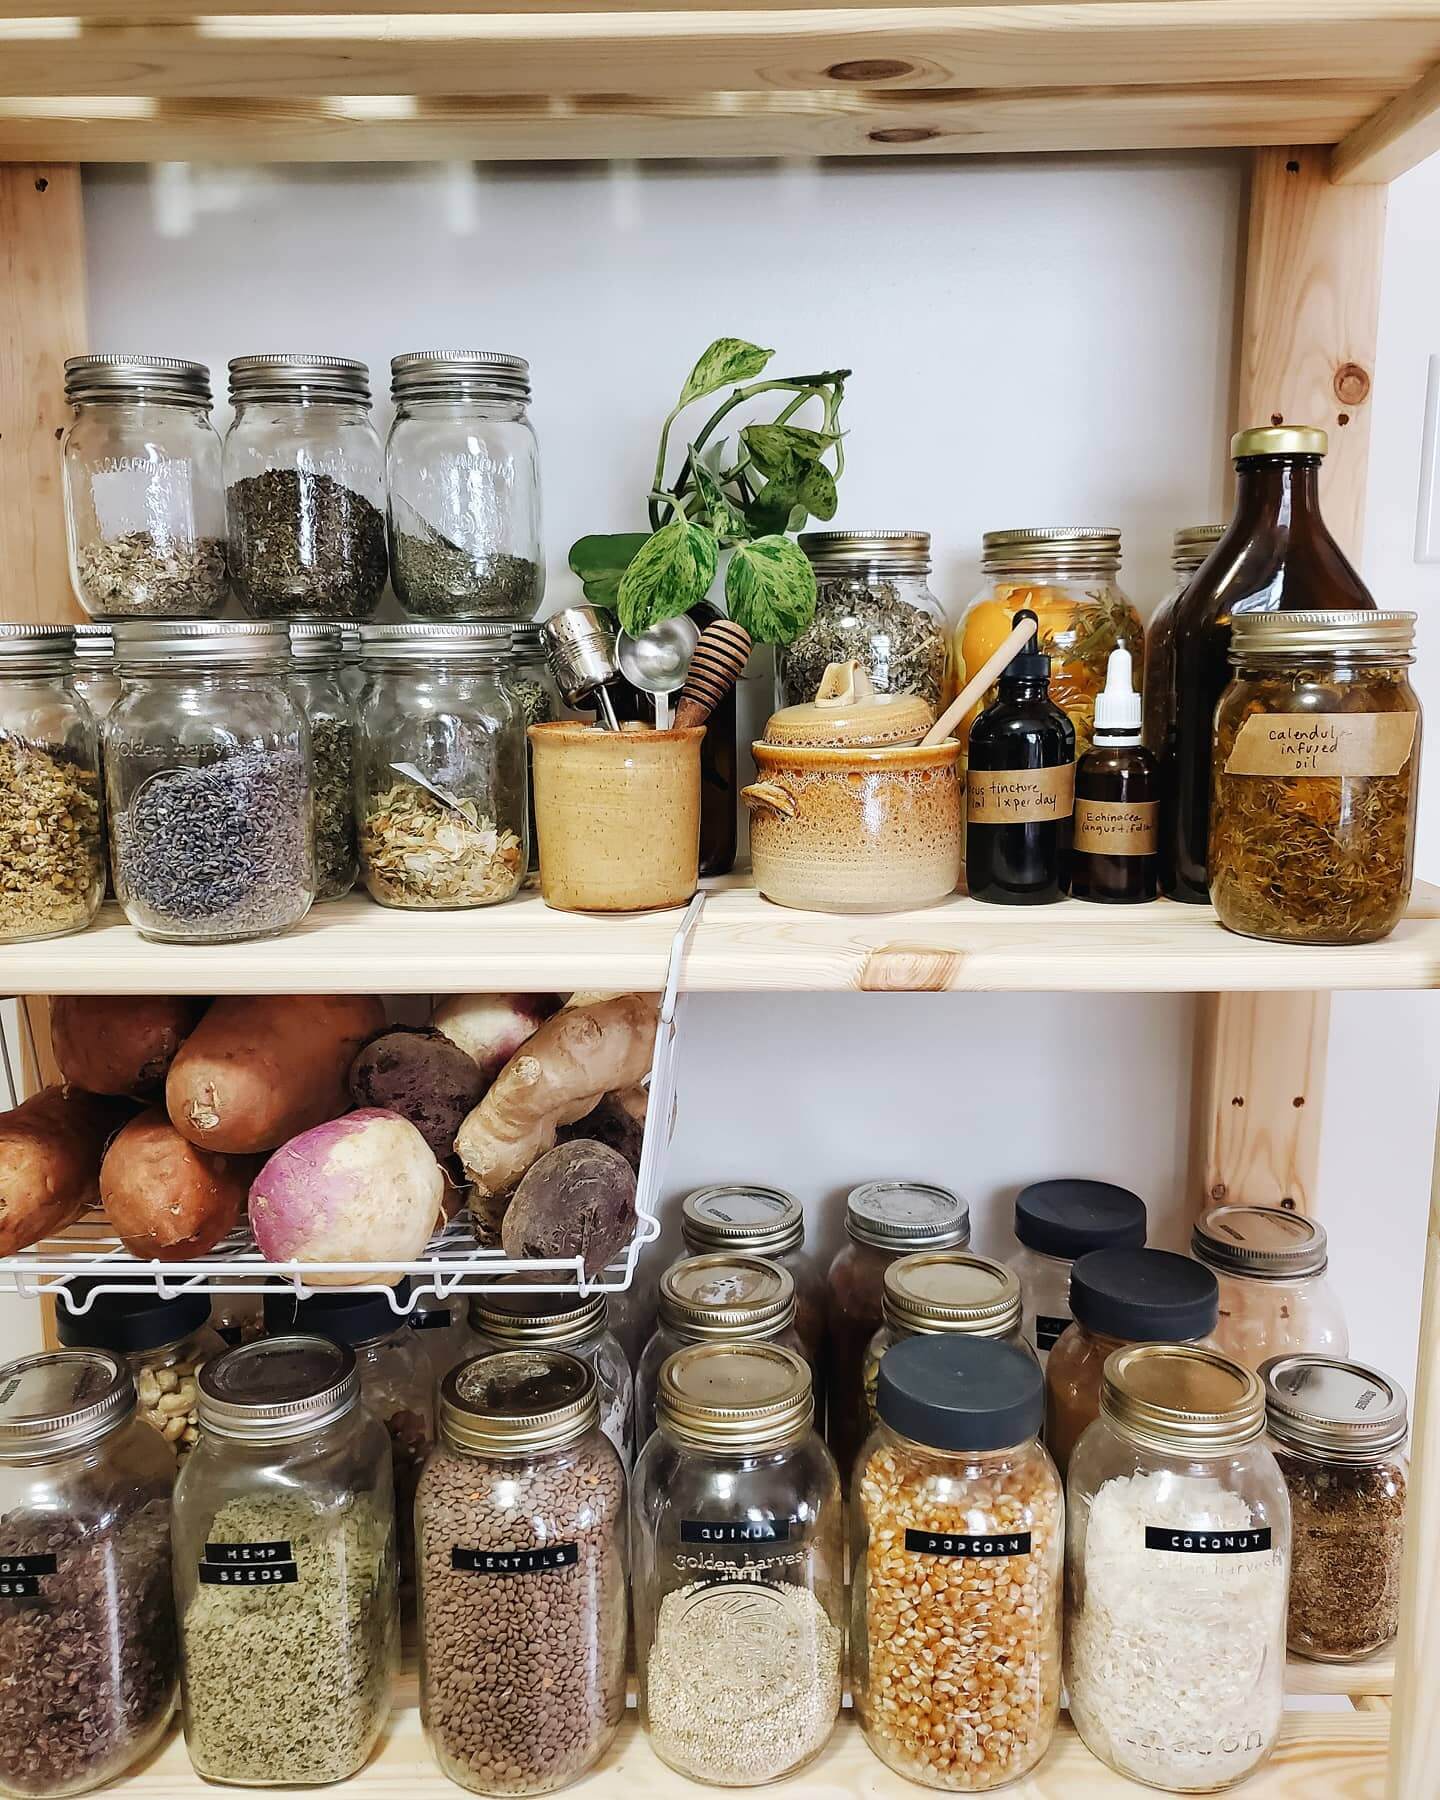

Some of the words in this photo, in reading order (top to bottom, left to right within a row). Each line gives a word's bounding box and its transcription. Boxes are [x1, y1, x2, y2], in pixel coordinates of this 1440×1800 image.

[1281, 737, 1339, 754] infused
[1295, 755, 1316, 769] oil
[989, 780, 1039, 794] tincture
[1035, 792, 1057, 812] day
[928, 1539, 1020, 1553] POPCORN
[1171, 1534, 1261, 1549] COCONUT
[226, 1548, 277, 1560] HEMP
[472, 1551, 566, 1569] LENTILS
[220, 1569, 283, 1581] SEEDS
